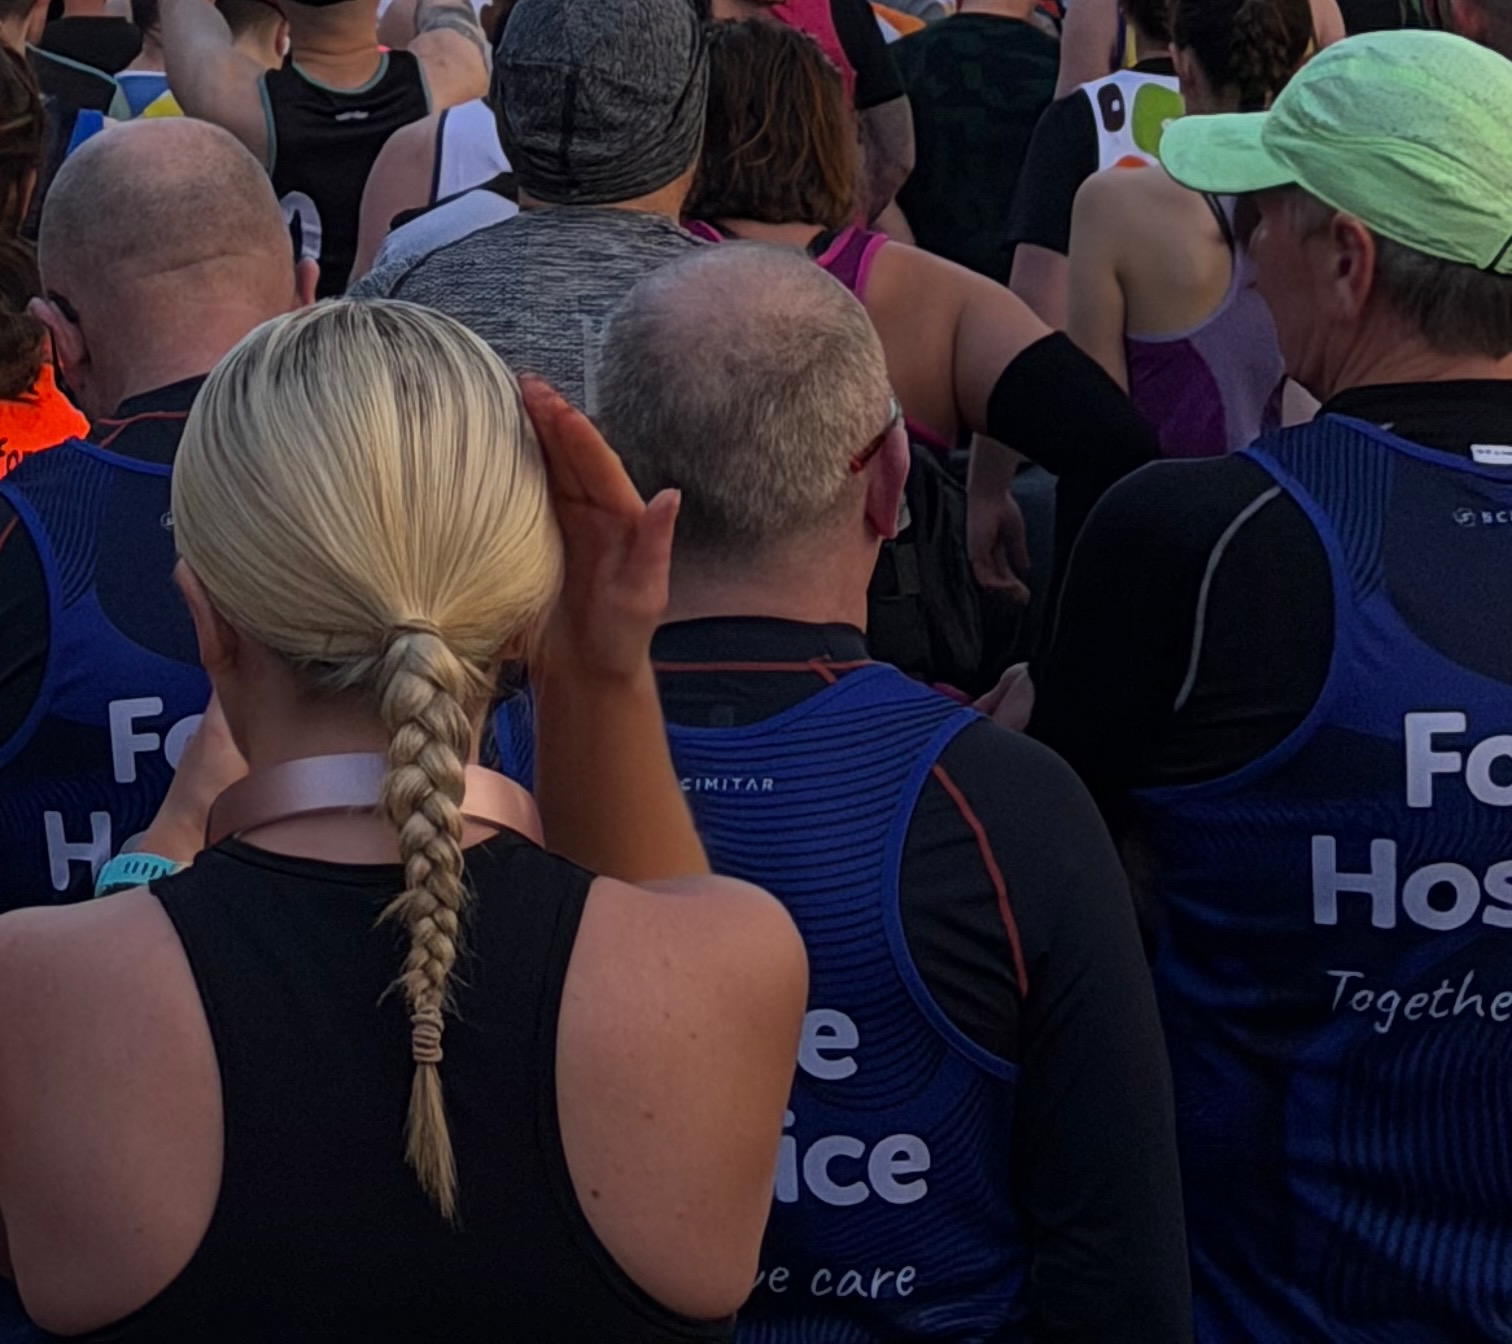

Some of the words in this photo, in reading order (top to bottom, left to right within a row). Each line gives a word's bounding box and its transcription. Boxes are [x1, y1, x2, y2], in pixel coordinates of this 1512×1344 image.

[679, 777, 775, 792] CIMITAR
[774, 1108, 931, 1207] ice
[810, 1265, 917, 1300] care
